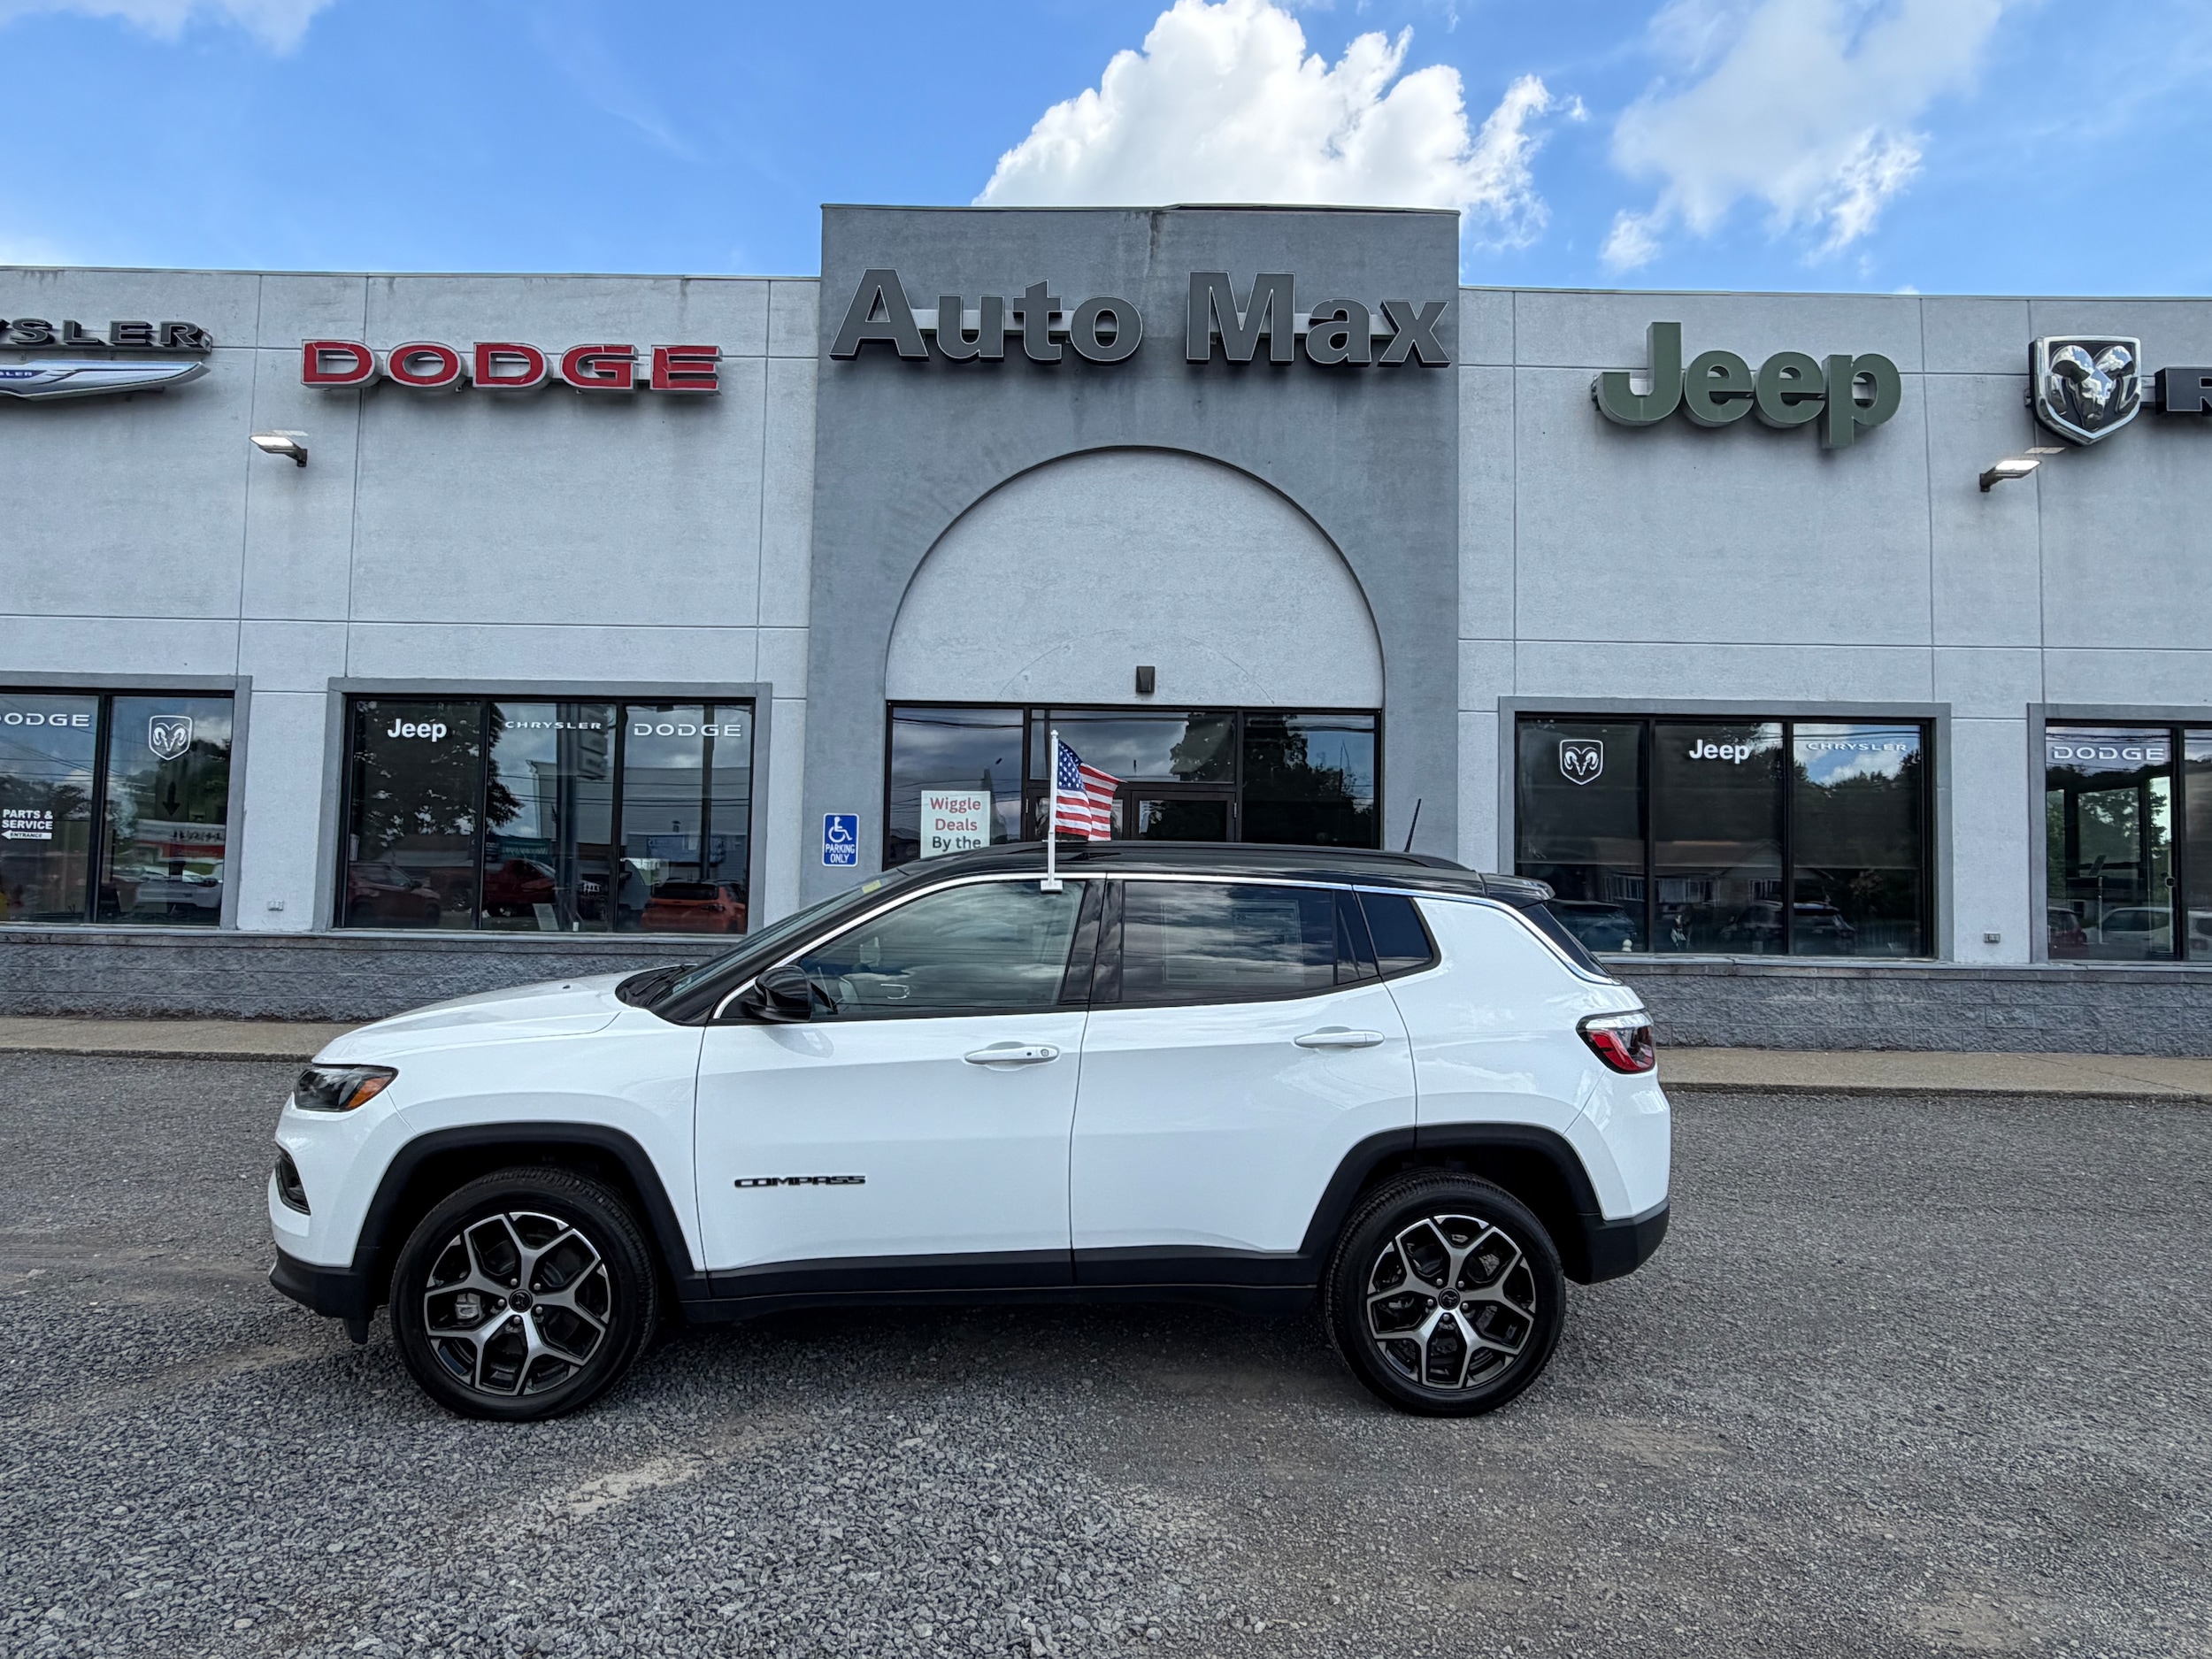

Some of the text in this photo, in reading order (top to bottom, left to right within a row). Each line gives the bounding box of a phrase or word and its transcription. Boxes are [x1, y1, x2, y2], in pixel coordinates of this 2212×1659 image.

[829, 268, 1453, 366] Auto Max
[0, 319, 204, 349] SLER
[301, 340, 722, 395] DODGE
[1596, 322, 1901, 447] Jeep
[0, 713, 90, 726] ODGE
[504, 721, 602, 730] CHRYSLER
[387, 718, 447, 742] Jeep
[634, 723, 742, 737] DODGE
[1689, 740, 1750, 764] Jeep
[1807, 742, 1908, 751] CHRYSLER
[2054, 746, 2164, 761] DODGE
[930, 797, 981, 813] Wiggle
[3, 809, 53, 819] PARTS &
[2, 819, 53, 830] SERVICE
[935, 818, 978, 831] Deals
[825, 843, 856, 854] PARKING
[932, 835, 981, 852] By the
[830, 854, 849, 864] ONLY
[734, 1175, 866, 1188] COMPASS
